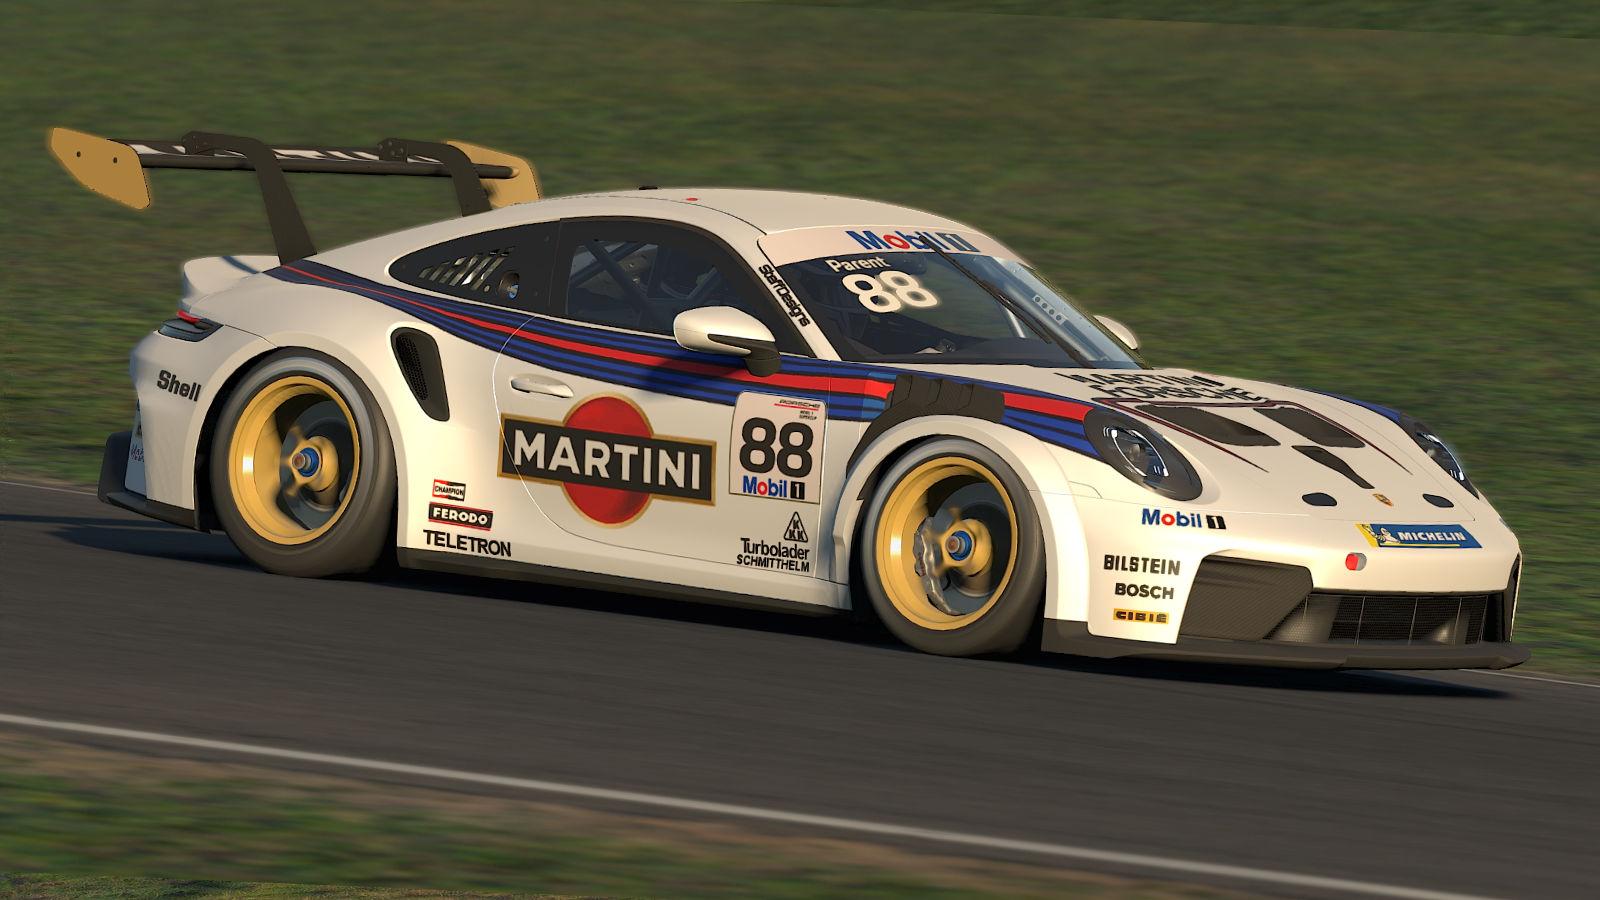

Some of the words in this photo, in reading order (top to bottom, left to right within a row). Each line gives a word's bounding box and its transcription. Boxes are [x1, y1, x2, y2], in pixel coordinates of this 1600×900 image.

[845, 231, 951, 250] Mobl
[825, 256, 891, 273] Parent
[842, 270, 938, 313] 88
[157, 369, 202, 402] Shell
[740, 417, 813, 478] 88
[514, 429, 700, 490] MARTINI
[434, 486, 464, 496] CHAMPION
[743, 475, 787, 497] Mobil
[433, 507, 488, 525] FERODO
[1141, 508, 1202, 528] Mobil
[423, 529, 511, 557] TELETRON
[1397, 532, 1466, 541] MICHELIN
[740, 537, 810, 560] Turbolader
[736, 554, 810, 572] SCHMITTHELM
[1103, 554, 1181, 576] BILSTEIN
[1115, 582, 1174, 600] BOSCH
